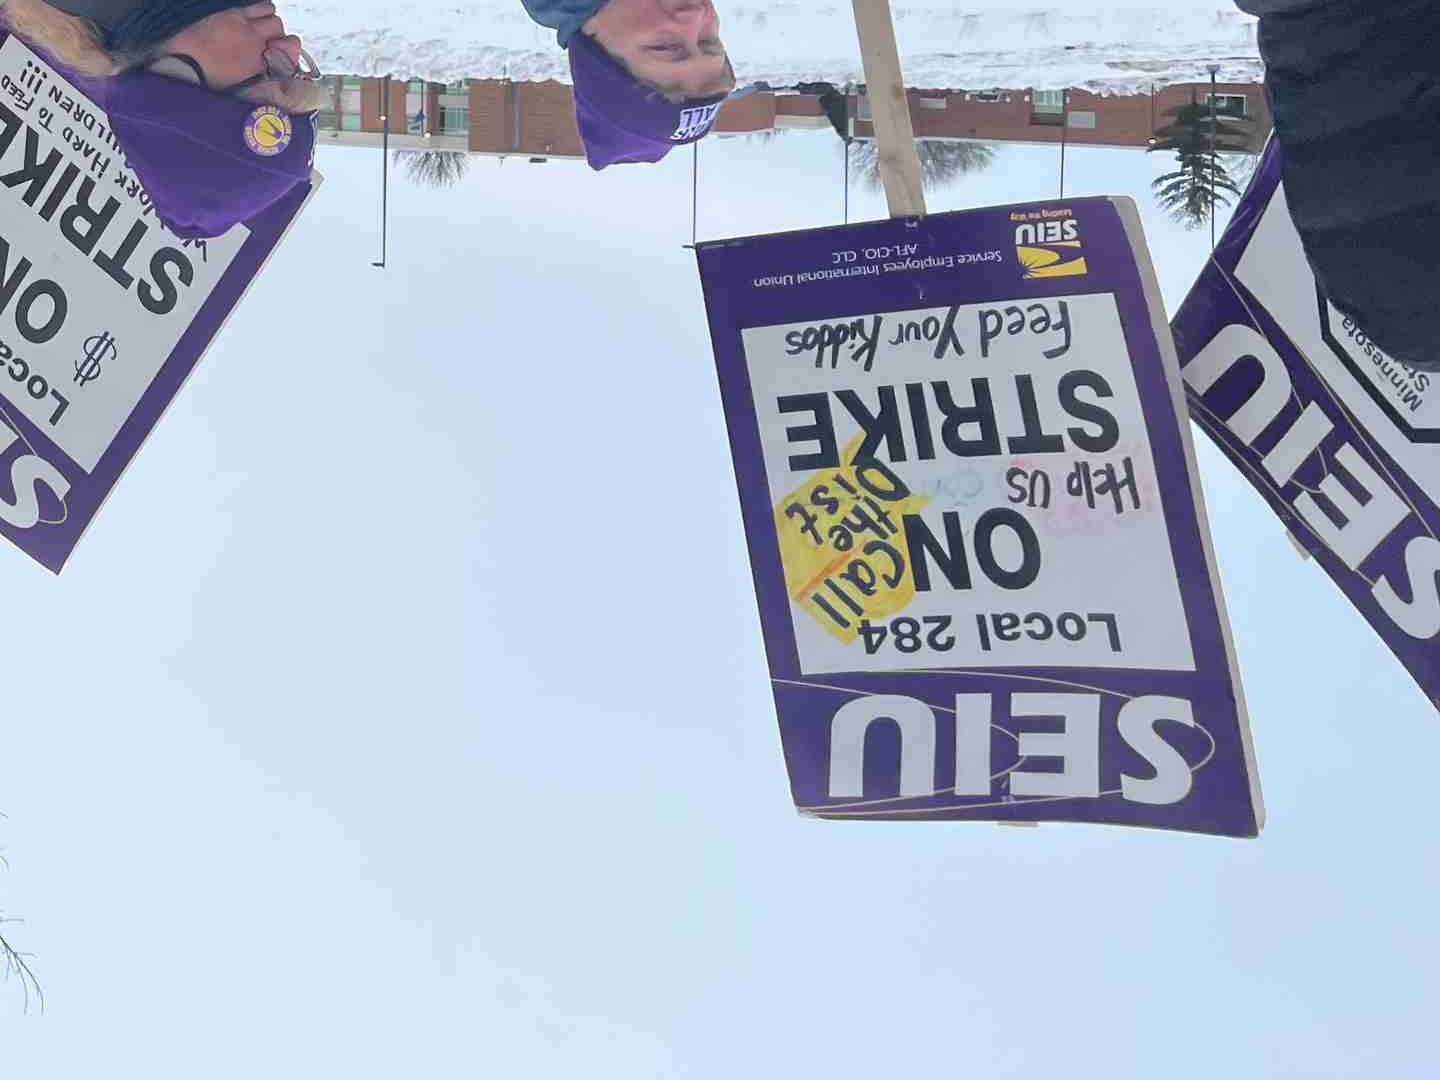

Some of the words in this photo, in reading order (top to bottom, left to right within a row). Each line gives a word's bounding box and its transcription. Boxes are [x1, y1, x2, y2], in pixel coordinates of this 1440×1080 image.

[0, 74, 34, 111] FEED
[62, 127, 111, 178] HARD
[832, 250, 857, 263] CLC
[957, 250, 1002, 264] Service
[1015, 219, 1078, 245] SEIU
[753, 274, 794, 288] Union
[797, 264, 880, 284] International
[883, 256, 954, 273] Employees
[784, 316, 882, 372] Kiddos
[889, 304, 964, 359] Your
[978, 301, 1071, 359] Feed
[73, 331, 117, 387] $
[1342, 317, 1423, 412] Minnesota
[776, 369, 1120, 472] STRIKE
[785, 462, 910, 546] Dist
[1066, 457, 1140, 514] Help
[828, 496, 898, 552] the
[901, 506, 1042, 593] ON
[810, 540, 905, 629] Call
[857, 614, 956, 656] 284
[975, 612, 1122, 652] Local
[827, 692, 1195, 806] SEIU
